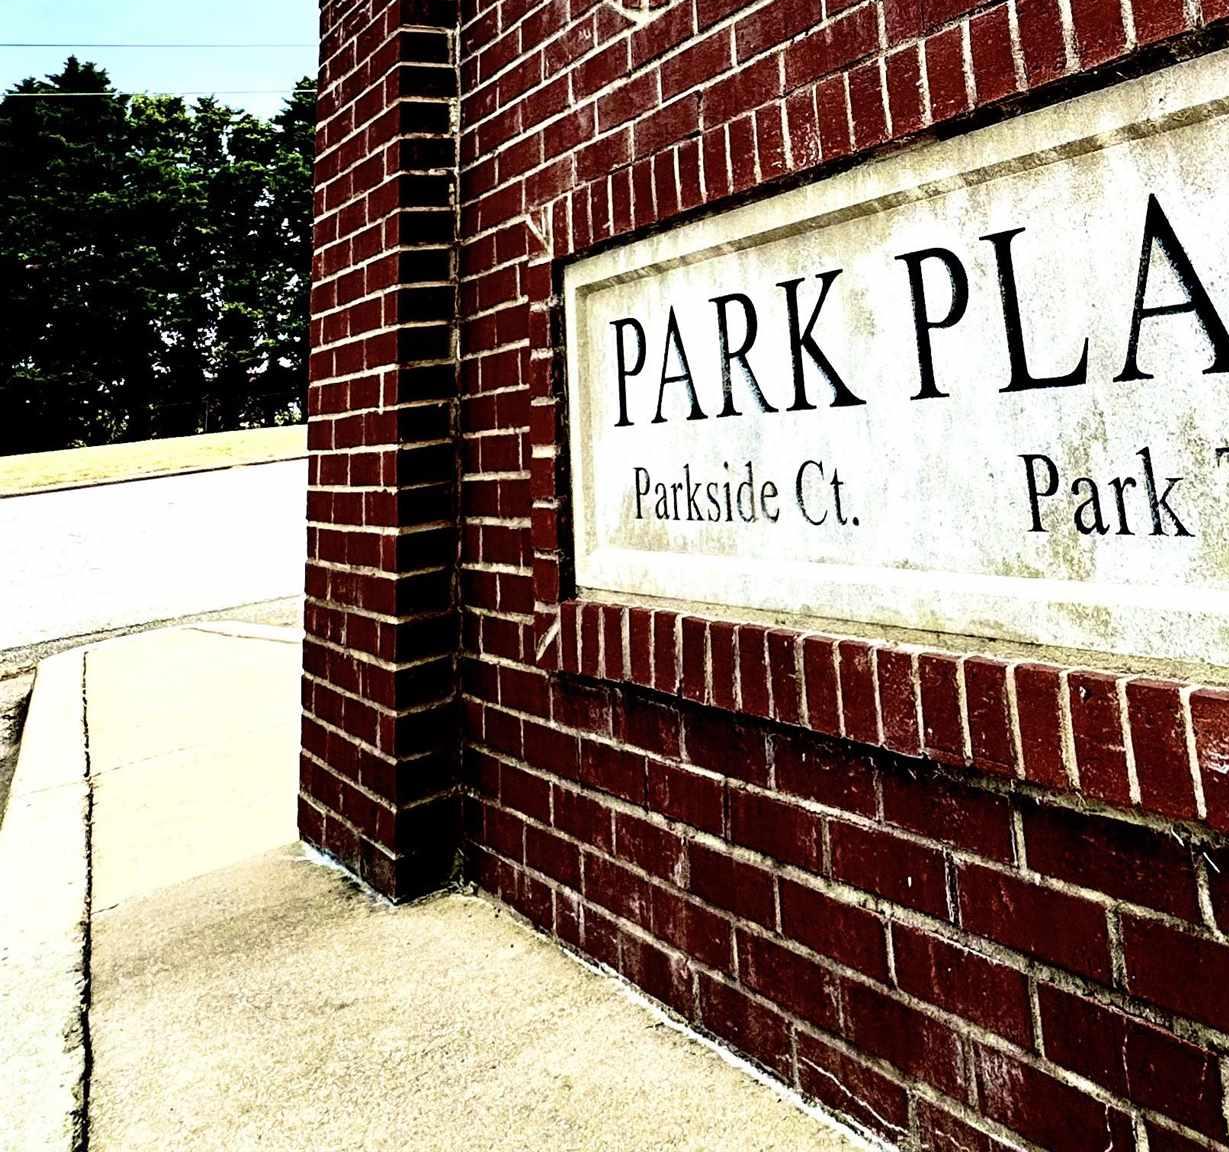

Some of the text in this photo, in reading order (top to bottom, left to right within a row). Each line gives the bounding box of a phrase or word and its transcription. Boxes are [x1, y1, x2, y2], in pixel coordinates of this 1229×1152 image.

[609, 268, 867, 428] PARK
[633, 458, 861, 528] Parkside Ct.
[1017, 446, 1196, 539] Park
